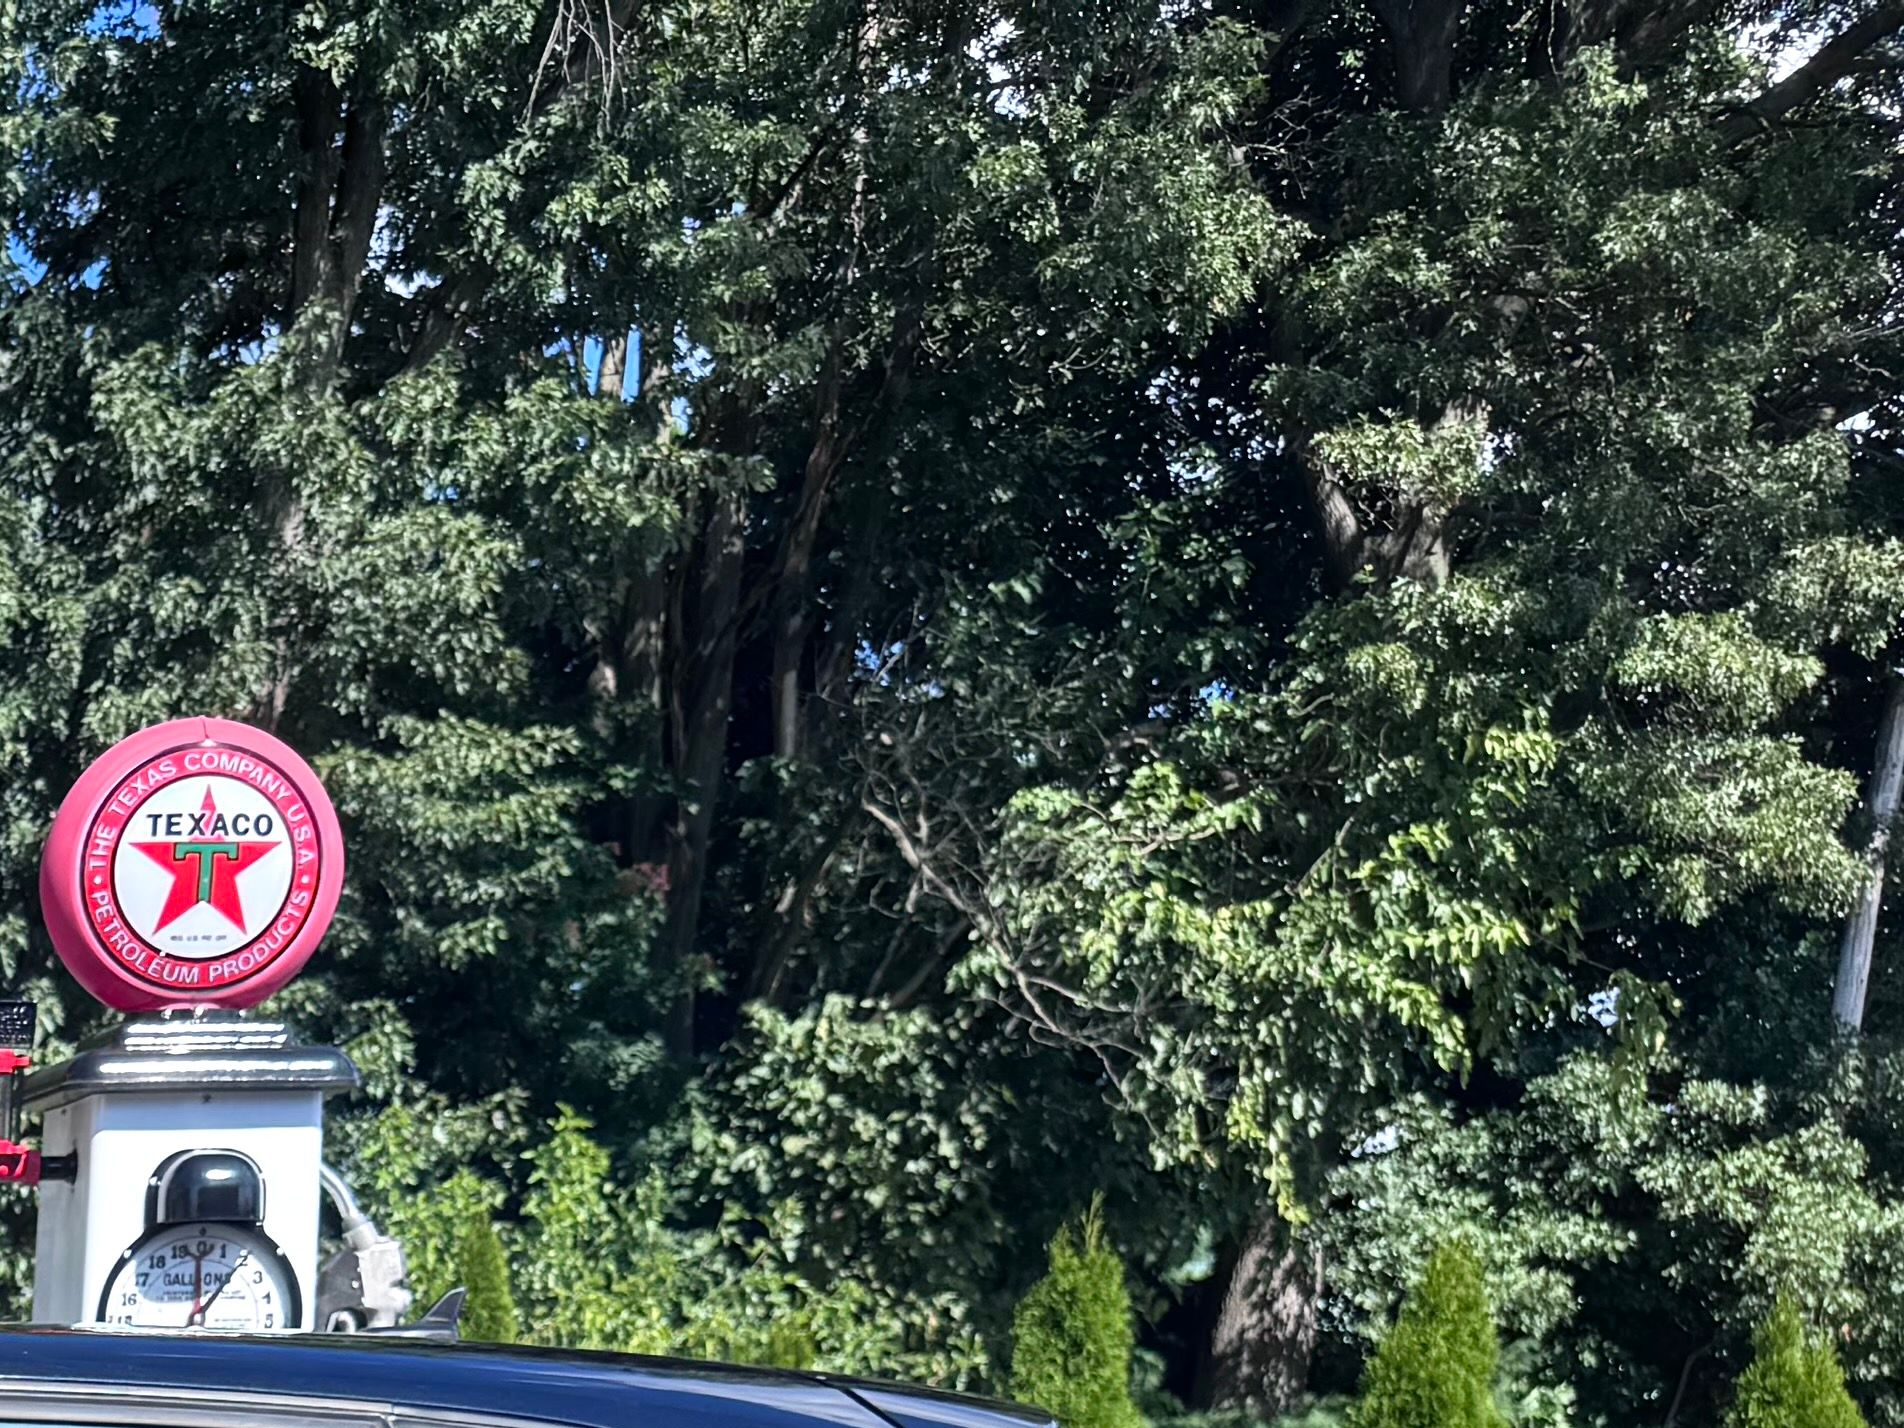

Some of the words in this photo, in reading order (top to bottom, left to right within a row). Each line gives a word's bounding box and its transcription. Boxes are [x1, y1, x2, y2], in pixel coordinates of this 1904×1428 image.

[89, 823, 116, 869] THE
[109, 760, 177, 816] TEXAS
[184, 752, 290, 800] COMPANY
[146, 813, 273, 837] TEXACO
[174, 842, 239, 903] T
[90, 892, 199, 983] PETROLEUM
[209, 891, 308, 982] PRODUCTS
[220, 1244, 226, 1258] 1
[149, 1255, 166, 1269] 18
[253, 1270, 263, 1284] 3
[121, 1293, 137, 1306] 16
